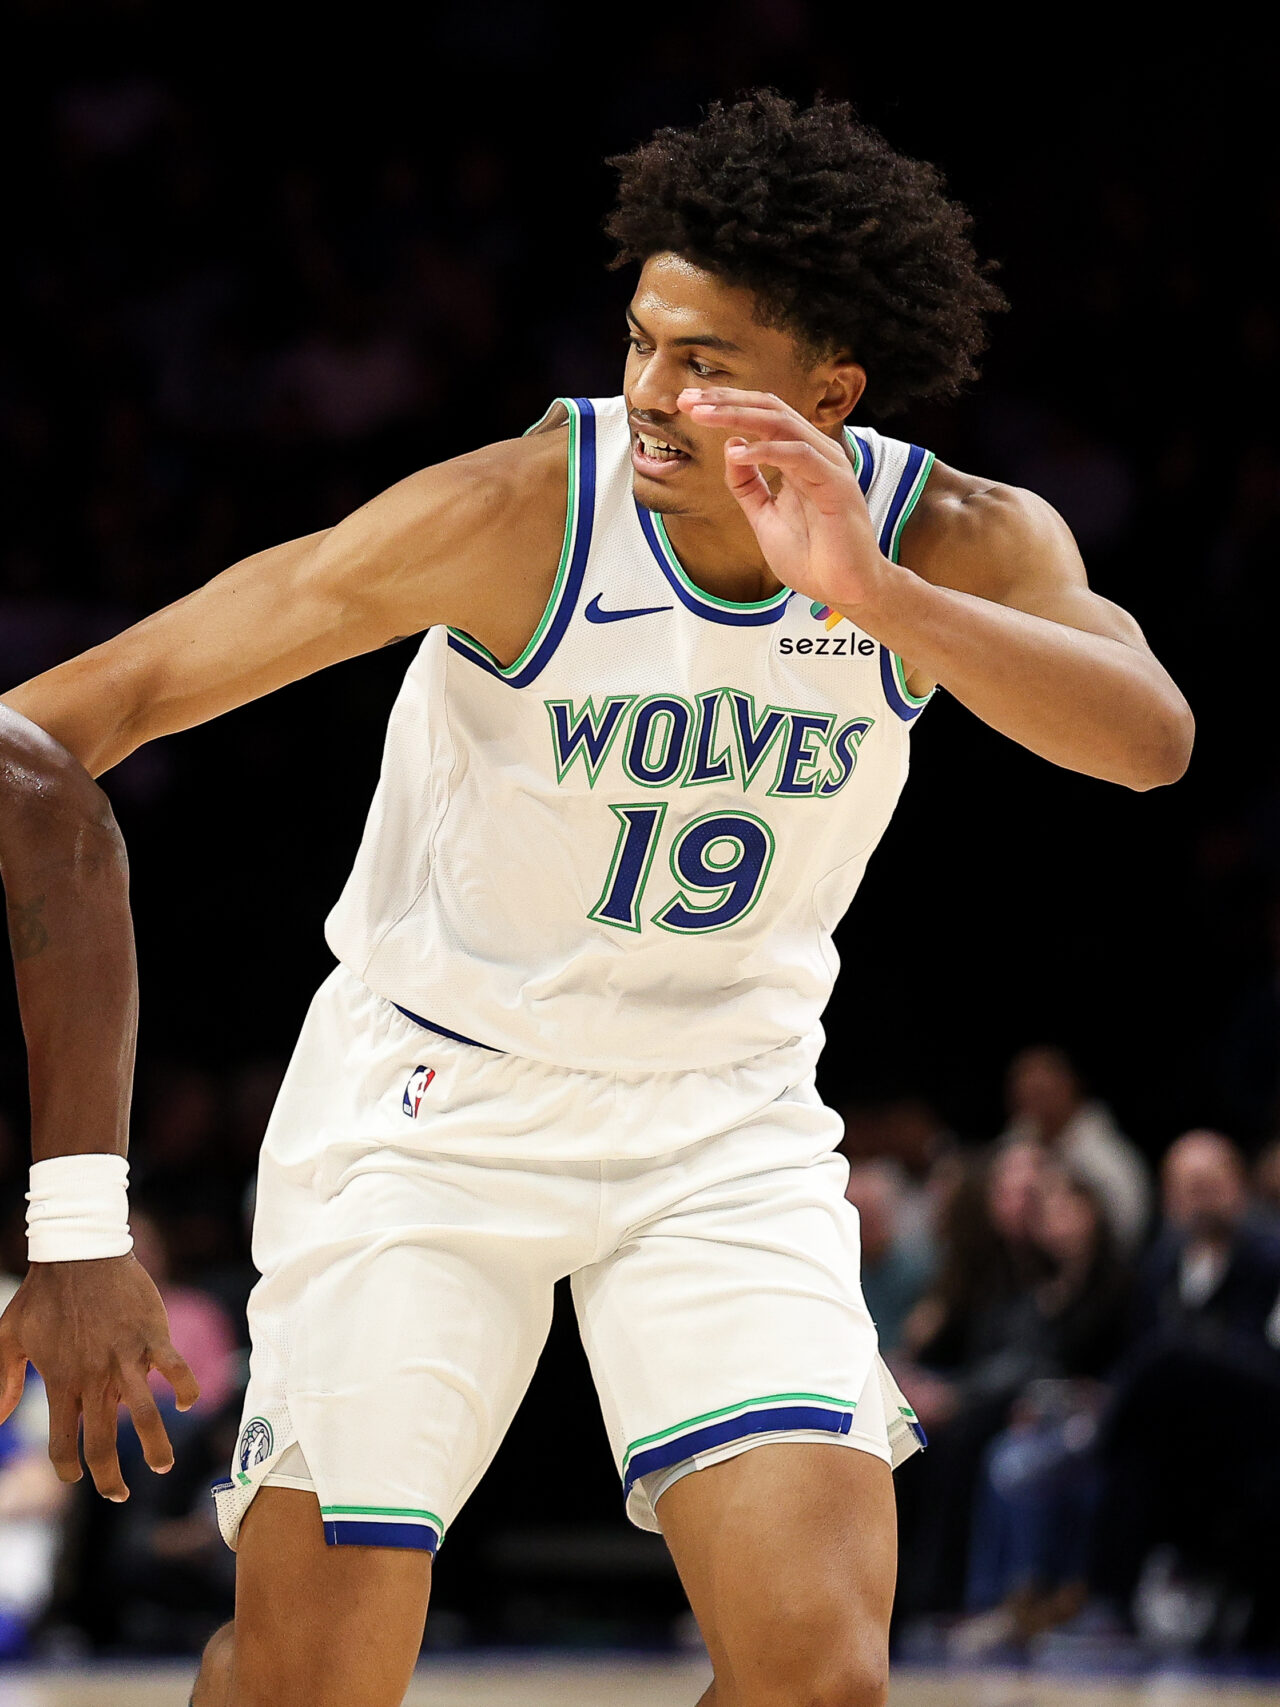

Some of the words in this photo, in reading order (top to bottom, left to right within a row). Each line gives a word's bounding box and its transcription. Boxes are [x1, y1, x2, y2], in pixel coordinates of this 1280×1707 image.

[779, 631, 875, 656] sezzle
[544, 687, 875, 799] WOLVES
[587, 802, 776, 935] 19
